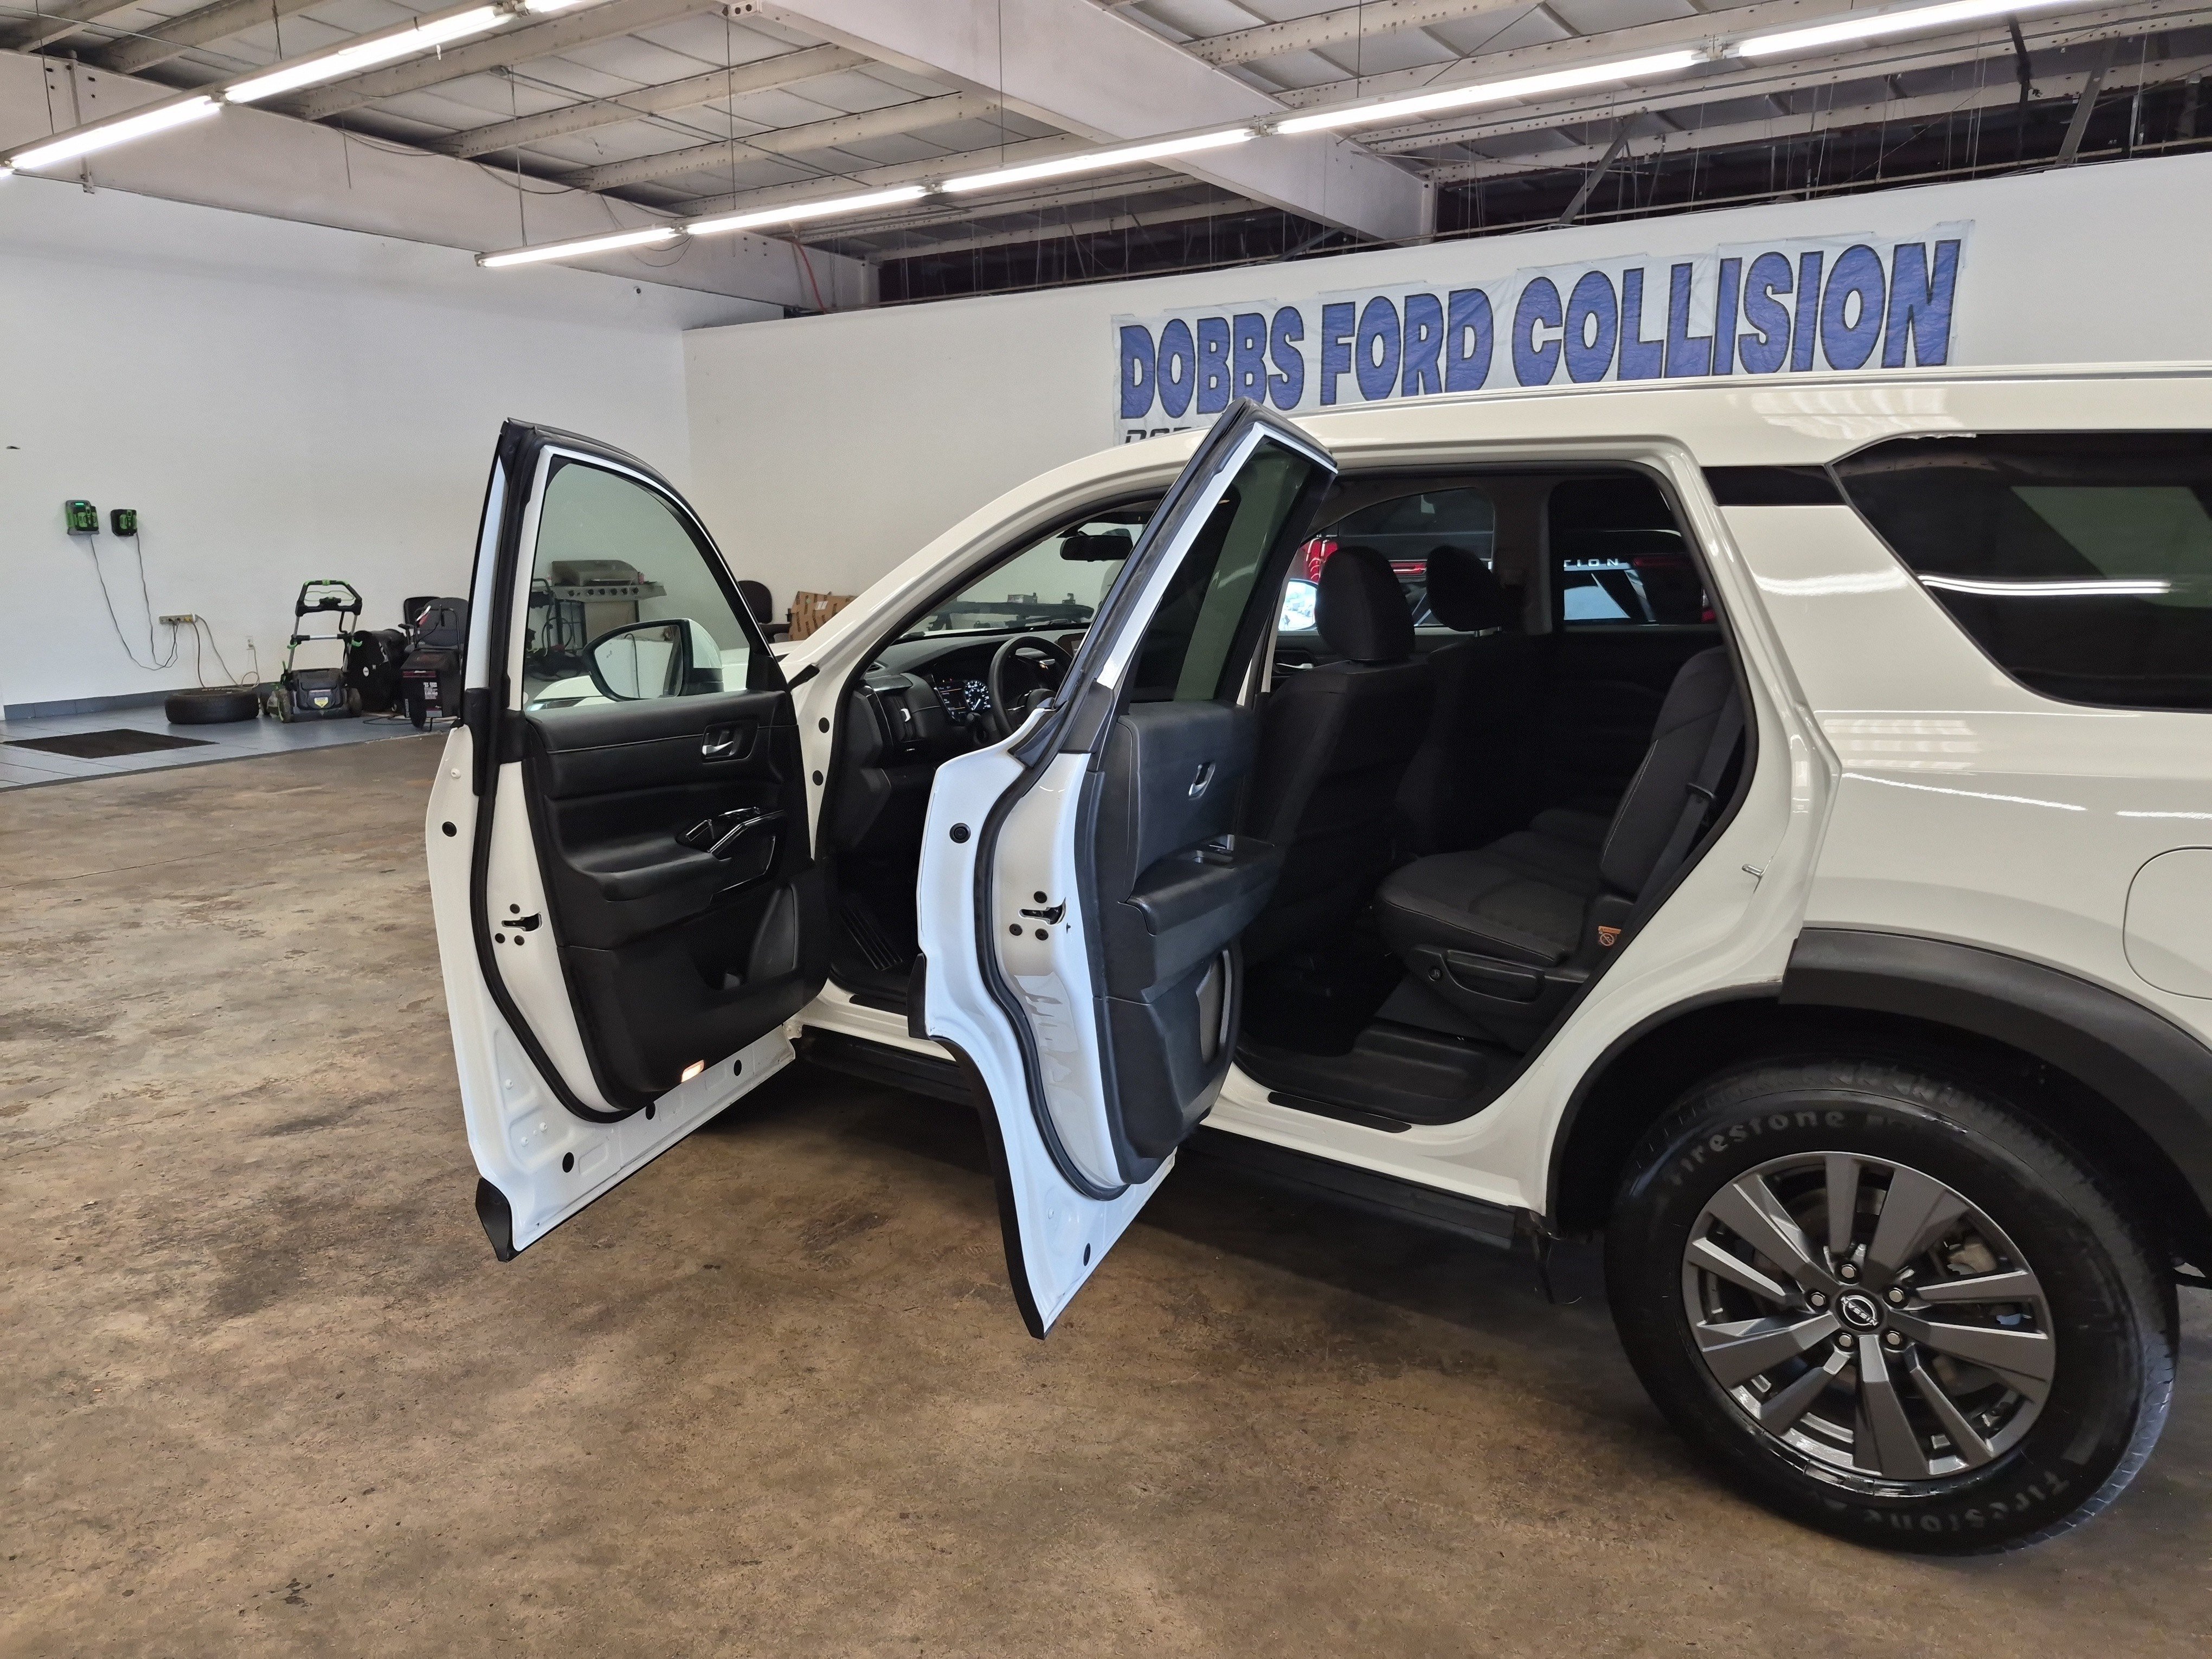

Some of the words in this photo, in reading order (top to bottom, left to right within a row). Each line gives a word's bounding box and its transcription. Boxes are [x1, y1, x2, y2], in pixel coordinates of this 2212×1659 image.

[1120, 306, 1304, 420] DOBBS
[1320, 288, 1494, 406] FORD
[1511, 239, 1962, 387] COLLISION
[1840, 1296, 1879, 1326] NISSAN
